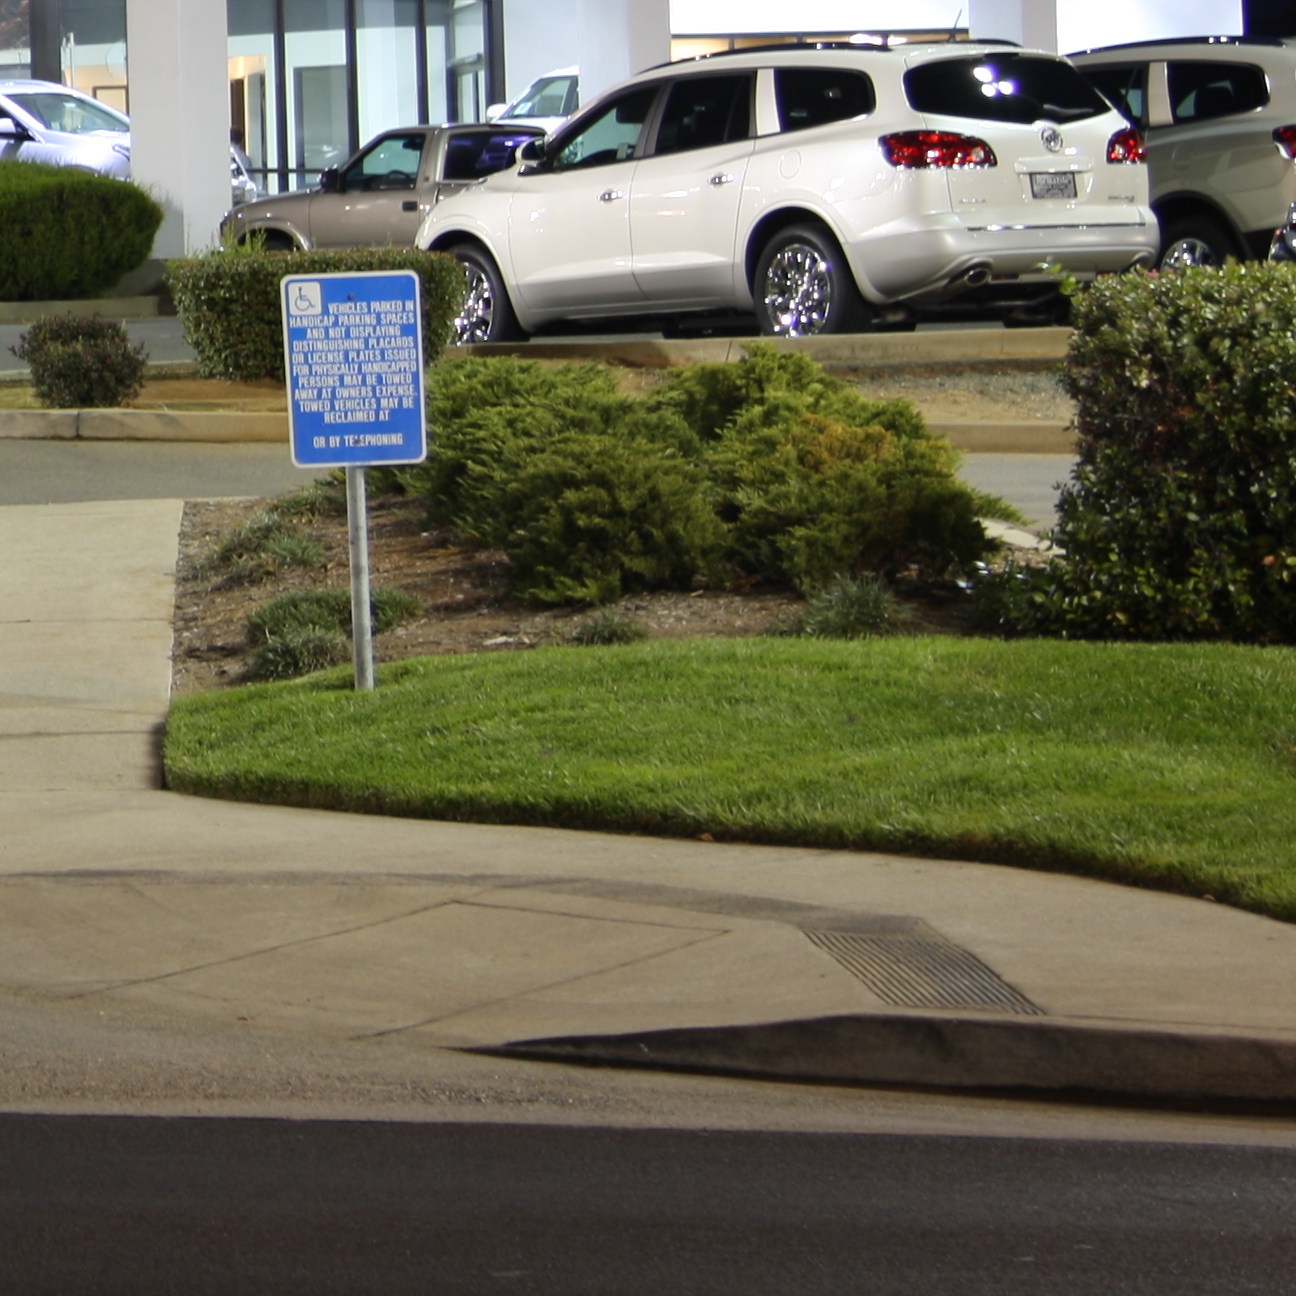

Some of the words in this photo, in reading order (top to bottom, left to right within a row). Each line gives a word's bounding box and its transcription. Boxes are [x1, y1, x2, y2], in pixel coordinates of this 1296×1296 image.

[328, 302, 368, 314] VEHICLES
[370, 300, 403, 313] PARKED
[405, 300, 414, 311] IN
[289, 315, 335, 328] HANDICAP
[338, 313, 377, 326] PARKING
[380, 312, 415, 324] SPACES
[307, 328, 325, 339] AND
[328, 327, 346, 338] NOT
[349, 325, 401, 337] DISPLAYING
[293, 338, 365, 352] DISTINGUISHING
[369, 336, 414, 349] PLACARDS
[292, 353, 304, 364] OR
[308, 351, 345, 364] LICENSE
[348, 350, 381, 362] PLATES
[384, 348, 416, 361] ISSUED
[293, 364, 309, 376] FOR
[312, 363, 359, 375] PHYSICALLY
[361, 361, 417, 373] HANDICAPPED
[298, 375, 340, 388] PERSONS
[343, 374, 363, 386] MAY
[366, 374, 377, 385] BE
[381, 372, 412, 384] TOWED
[294, 388, 318, 400] AWAY
[321, 388, 332, 399] AT
[336, 386, 373, 398] OWNERS
[299, 400, 331, 412] TOWED
[334, 398, 377, 411] VEHICLES
[380, 397, 399, 409] MAY
[402, 396, 414, 408] BE
[324, 410, 375, 423] RECLAIMED
[378, 410, 390, 421] AT
[313, 436, 326, 448] OR
[329, 435, 341, 447] BY
